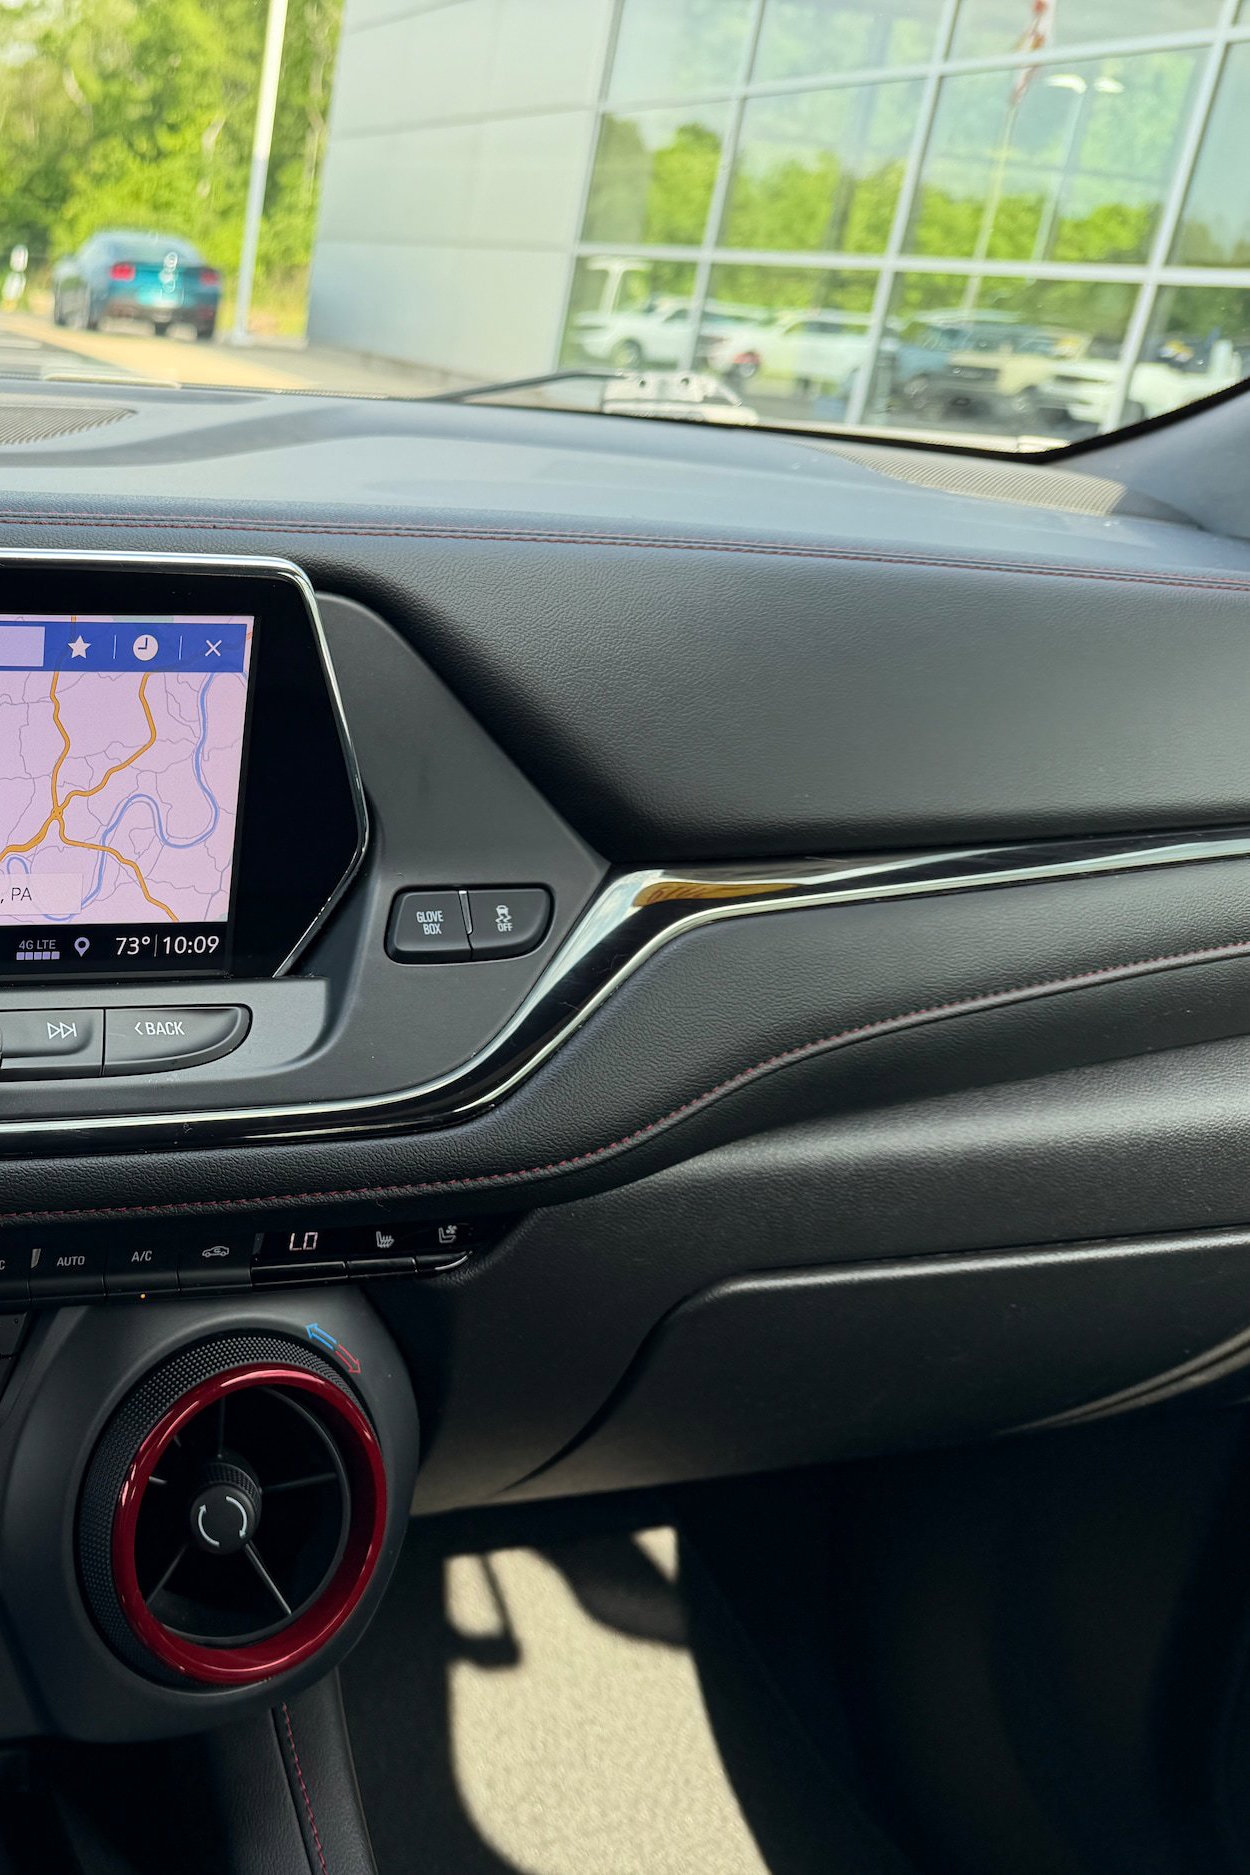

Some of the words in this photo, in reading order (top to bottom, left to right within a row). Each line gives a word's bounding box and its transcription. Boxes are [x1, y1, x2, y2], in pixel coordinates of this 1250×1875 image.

[10, 886, 33, 902] PA
[416, 910, 444, 923] GLOVE
[423, 923, 442, 935] BOX
[497, 922, 513, 932] OFF
[18, 940, 34, 950] 4G
[36, 939, 57, 950] LTE
[115, 936, 151, 956] 73°
[162, 935, 220, 955] 10:09
[56, 1255, 86, 1267] AUTO
[131, 1250, 153, 1263] A/C
